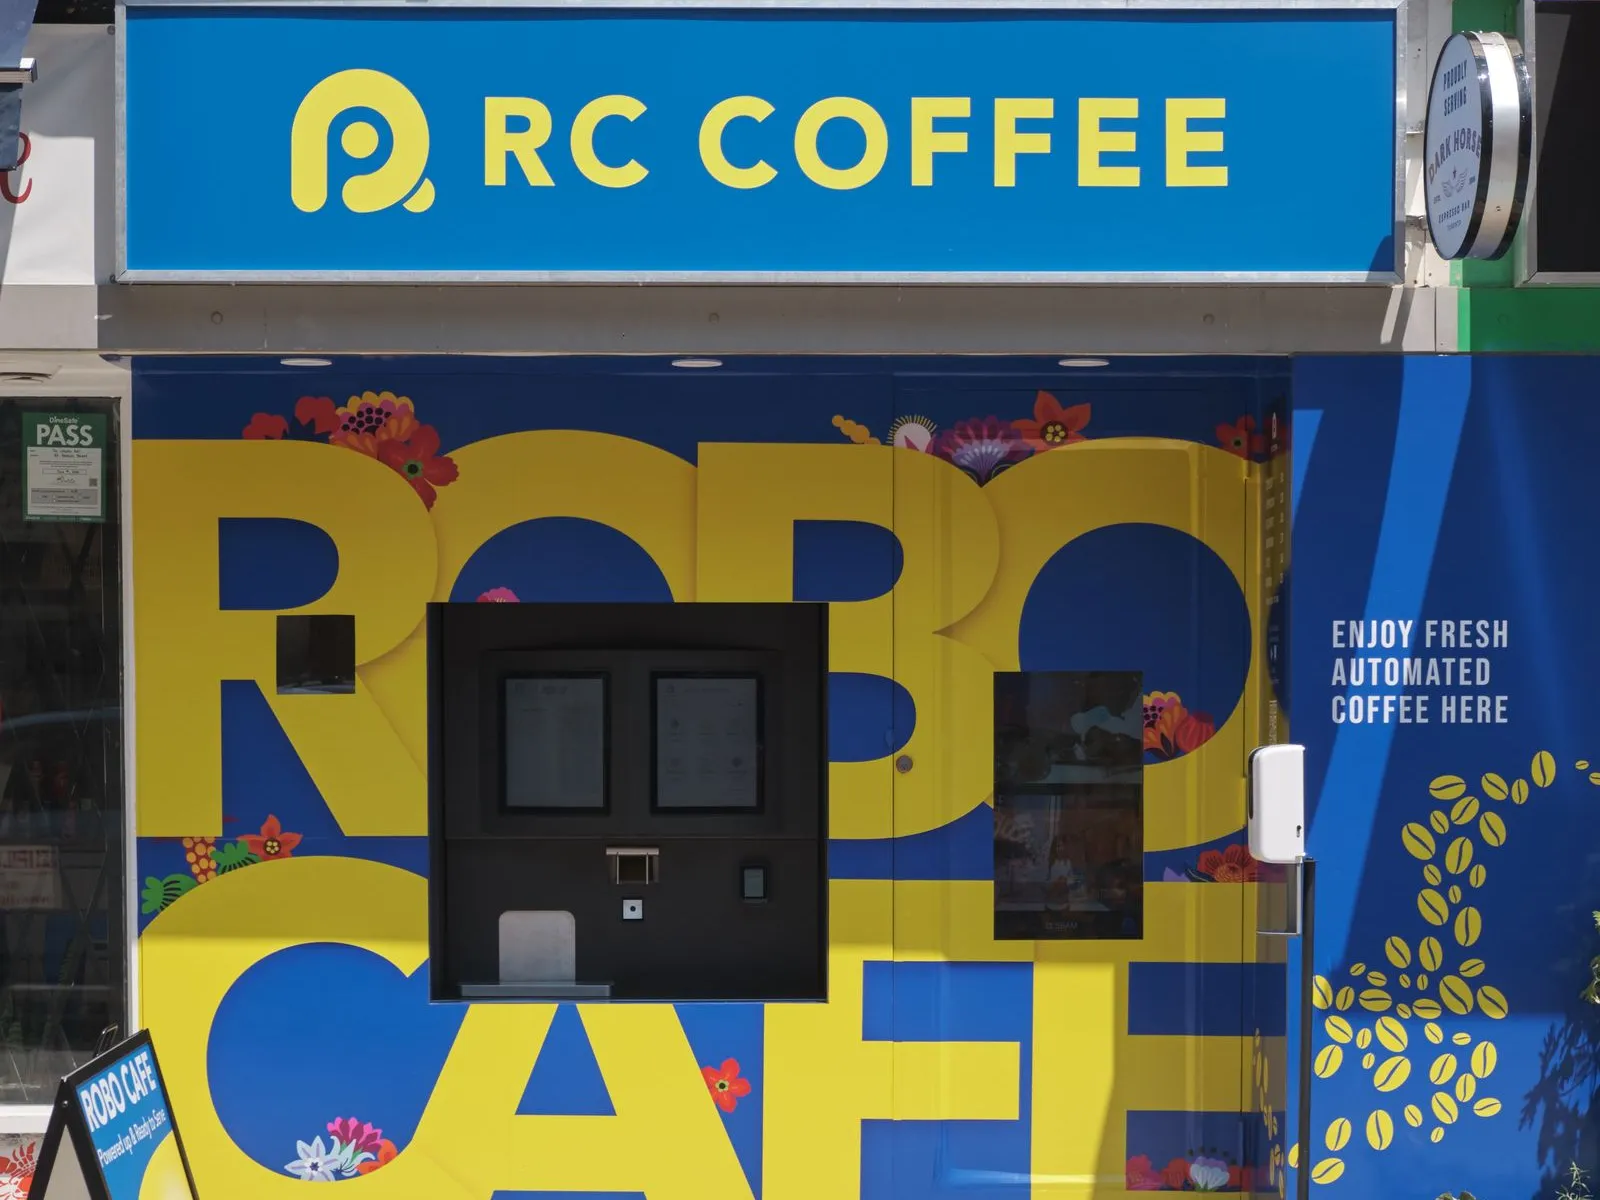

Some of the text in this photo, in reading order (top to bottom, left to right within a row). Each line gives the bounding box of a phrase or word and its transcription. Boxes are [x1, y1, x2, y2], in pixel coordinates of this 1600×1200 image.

[1443, 60, 1467, 91] PROUDLY
[1444, 86, 1467, 116] SERVING
[484, 94, 1229, 190] RC COFFEE
[1428, 127, 1482, 184] DARK HORSE
[37, 423, 93, 446] PASS
[1332, 619, 1509, 649] ENJOY FRESH
[1331, 657, 1491, 686] AUTOMATED
[1331, 695, 1509, 724] COFFEE HERE
[80, 1051, 156, 1133] ROBO CAFE
[97, 1134, 125, 1168] Powered
[133, 1116, 152, 1140] Ready
[152, 1109, 166, 1127] Serve
